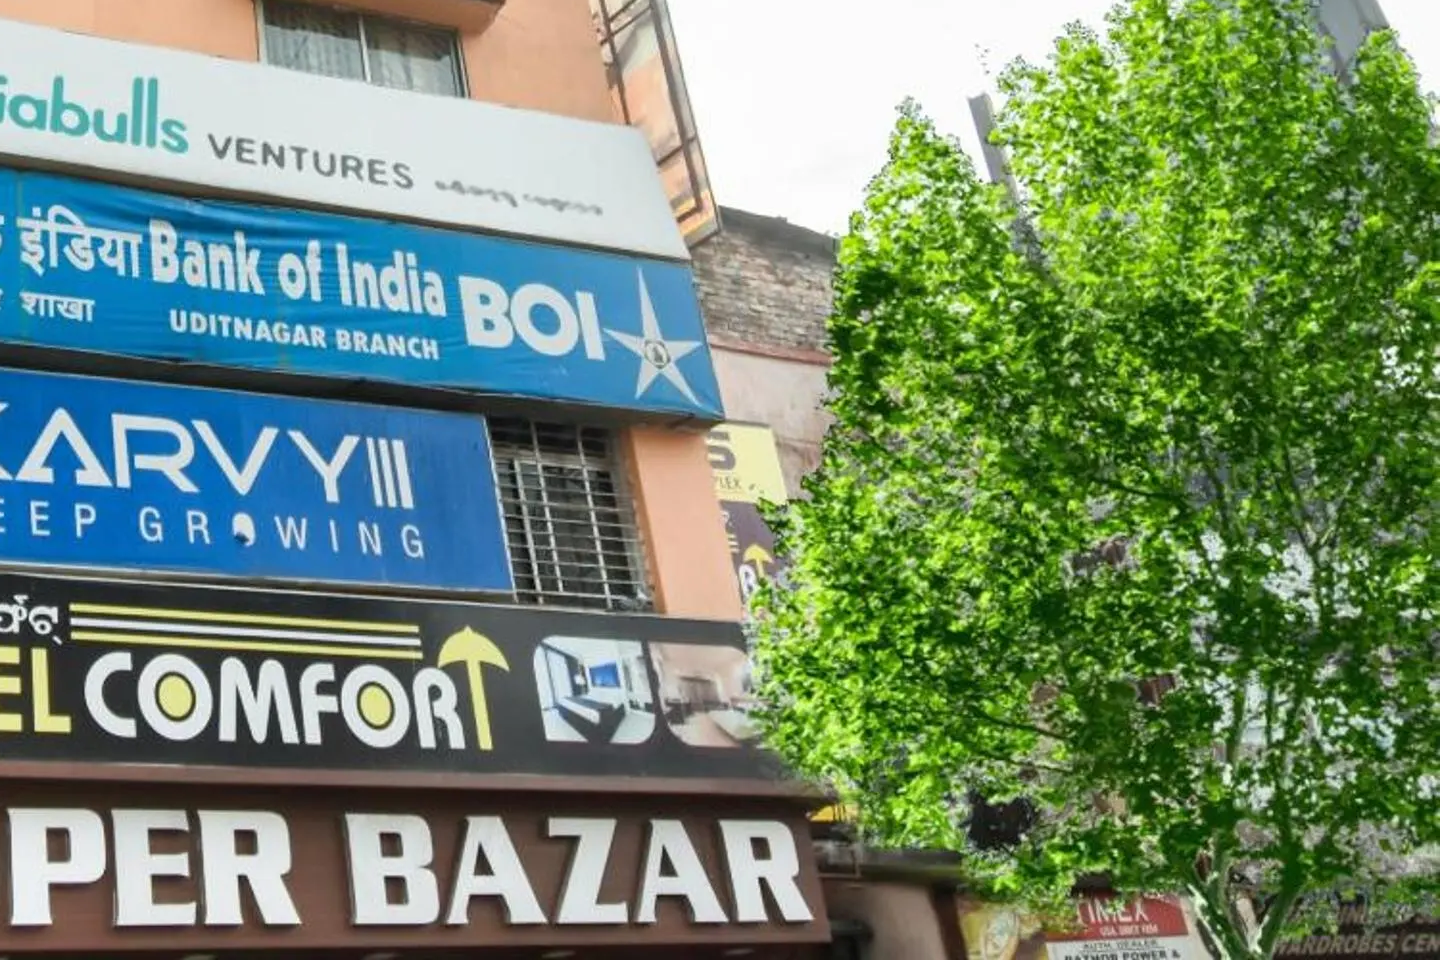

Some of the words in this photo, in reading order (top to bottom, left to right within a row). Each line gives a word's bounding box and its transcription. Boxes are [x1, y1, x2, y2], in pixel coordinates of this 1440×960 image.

[207, 132, 415, 191] VENTURES
[16, 205, 143, 277] इंडिया
[148, 218, 266, 296] Bank
[277, 238, 323, 302] of
[336, 242, 447, 318] India
[170, 308, 328, 349] UDITNAGAR
[336, 327, 440, 361] BRANCH
[459, 275, 606, 362] BOI
[138, 505, 425, 560] GROWING
[83, 626, 510, 751] COMFORT
[345, 813, 815, 925] BAZAR
